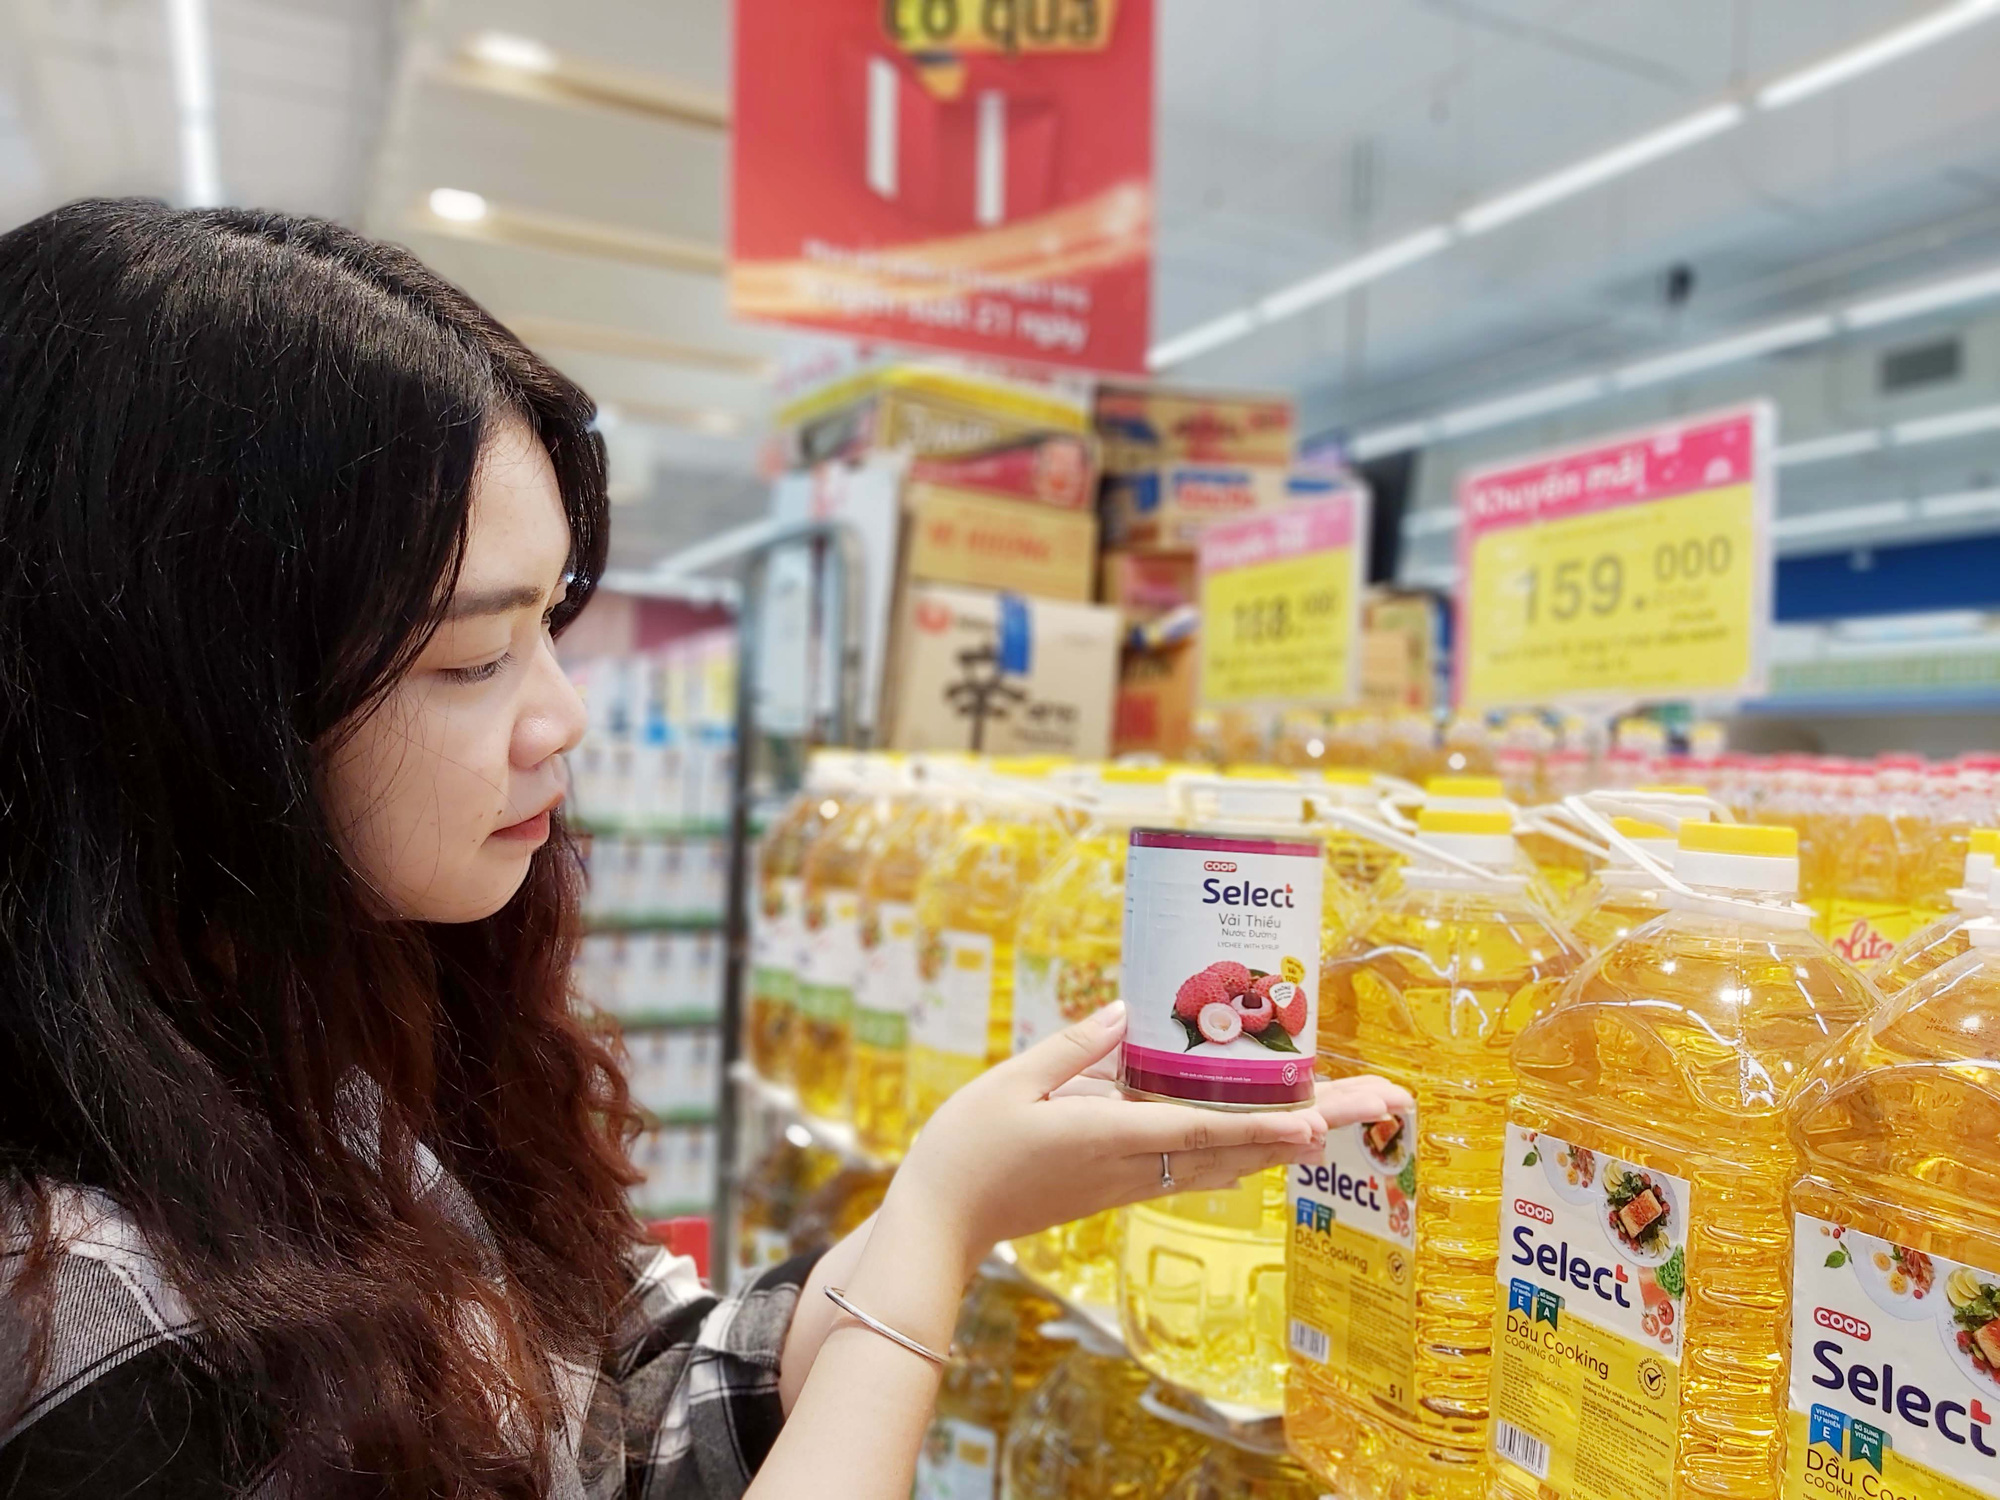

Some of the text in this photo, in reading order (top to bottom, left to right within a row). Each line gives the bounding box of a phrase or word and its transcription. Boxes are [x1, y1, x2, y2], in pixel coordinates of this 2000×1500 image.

[1652, 534, 1734, 584] 000
[1204, 862, 1237, 872] COOP
[1202, 878, 1294, 908] Select
[1297, 1162, 1381, 1211] Select
[1515, 1201, 1553, 1222] COOP
[1321, 1239, 1368, 1274] Cooking
[1511, 1225, 1631, 1308] Select
[1518, 1295, 1524, 1306] E
[1543, 1306, 1550, 1318] A
[1816, 1309, 1871, 1338] COOP
[1504, 1334, 1562, 1369] COOKING OIL
[1506, 1314, 1539, 1343] Dầu
[1543, 1331, 1609, 1380] Cooking
[1389, 1384, 1396, 1398] 5
[1811, 1340, 1997, 1458] Select
[1813, 1414, 1841, 1429] TỰ NHIÊN
[1815, 1407, 1840, 1421] VITAMIN
[1822, 1426, 1831, 1439] E
[1855, 1430, 1878, 1446] VITAMIN
[1862, 1427, 1880, 1439] SUNG
[1861, 1443, 1870, 1457] A
[1807, 1448, 1853, 1487] Dầu
